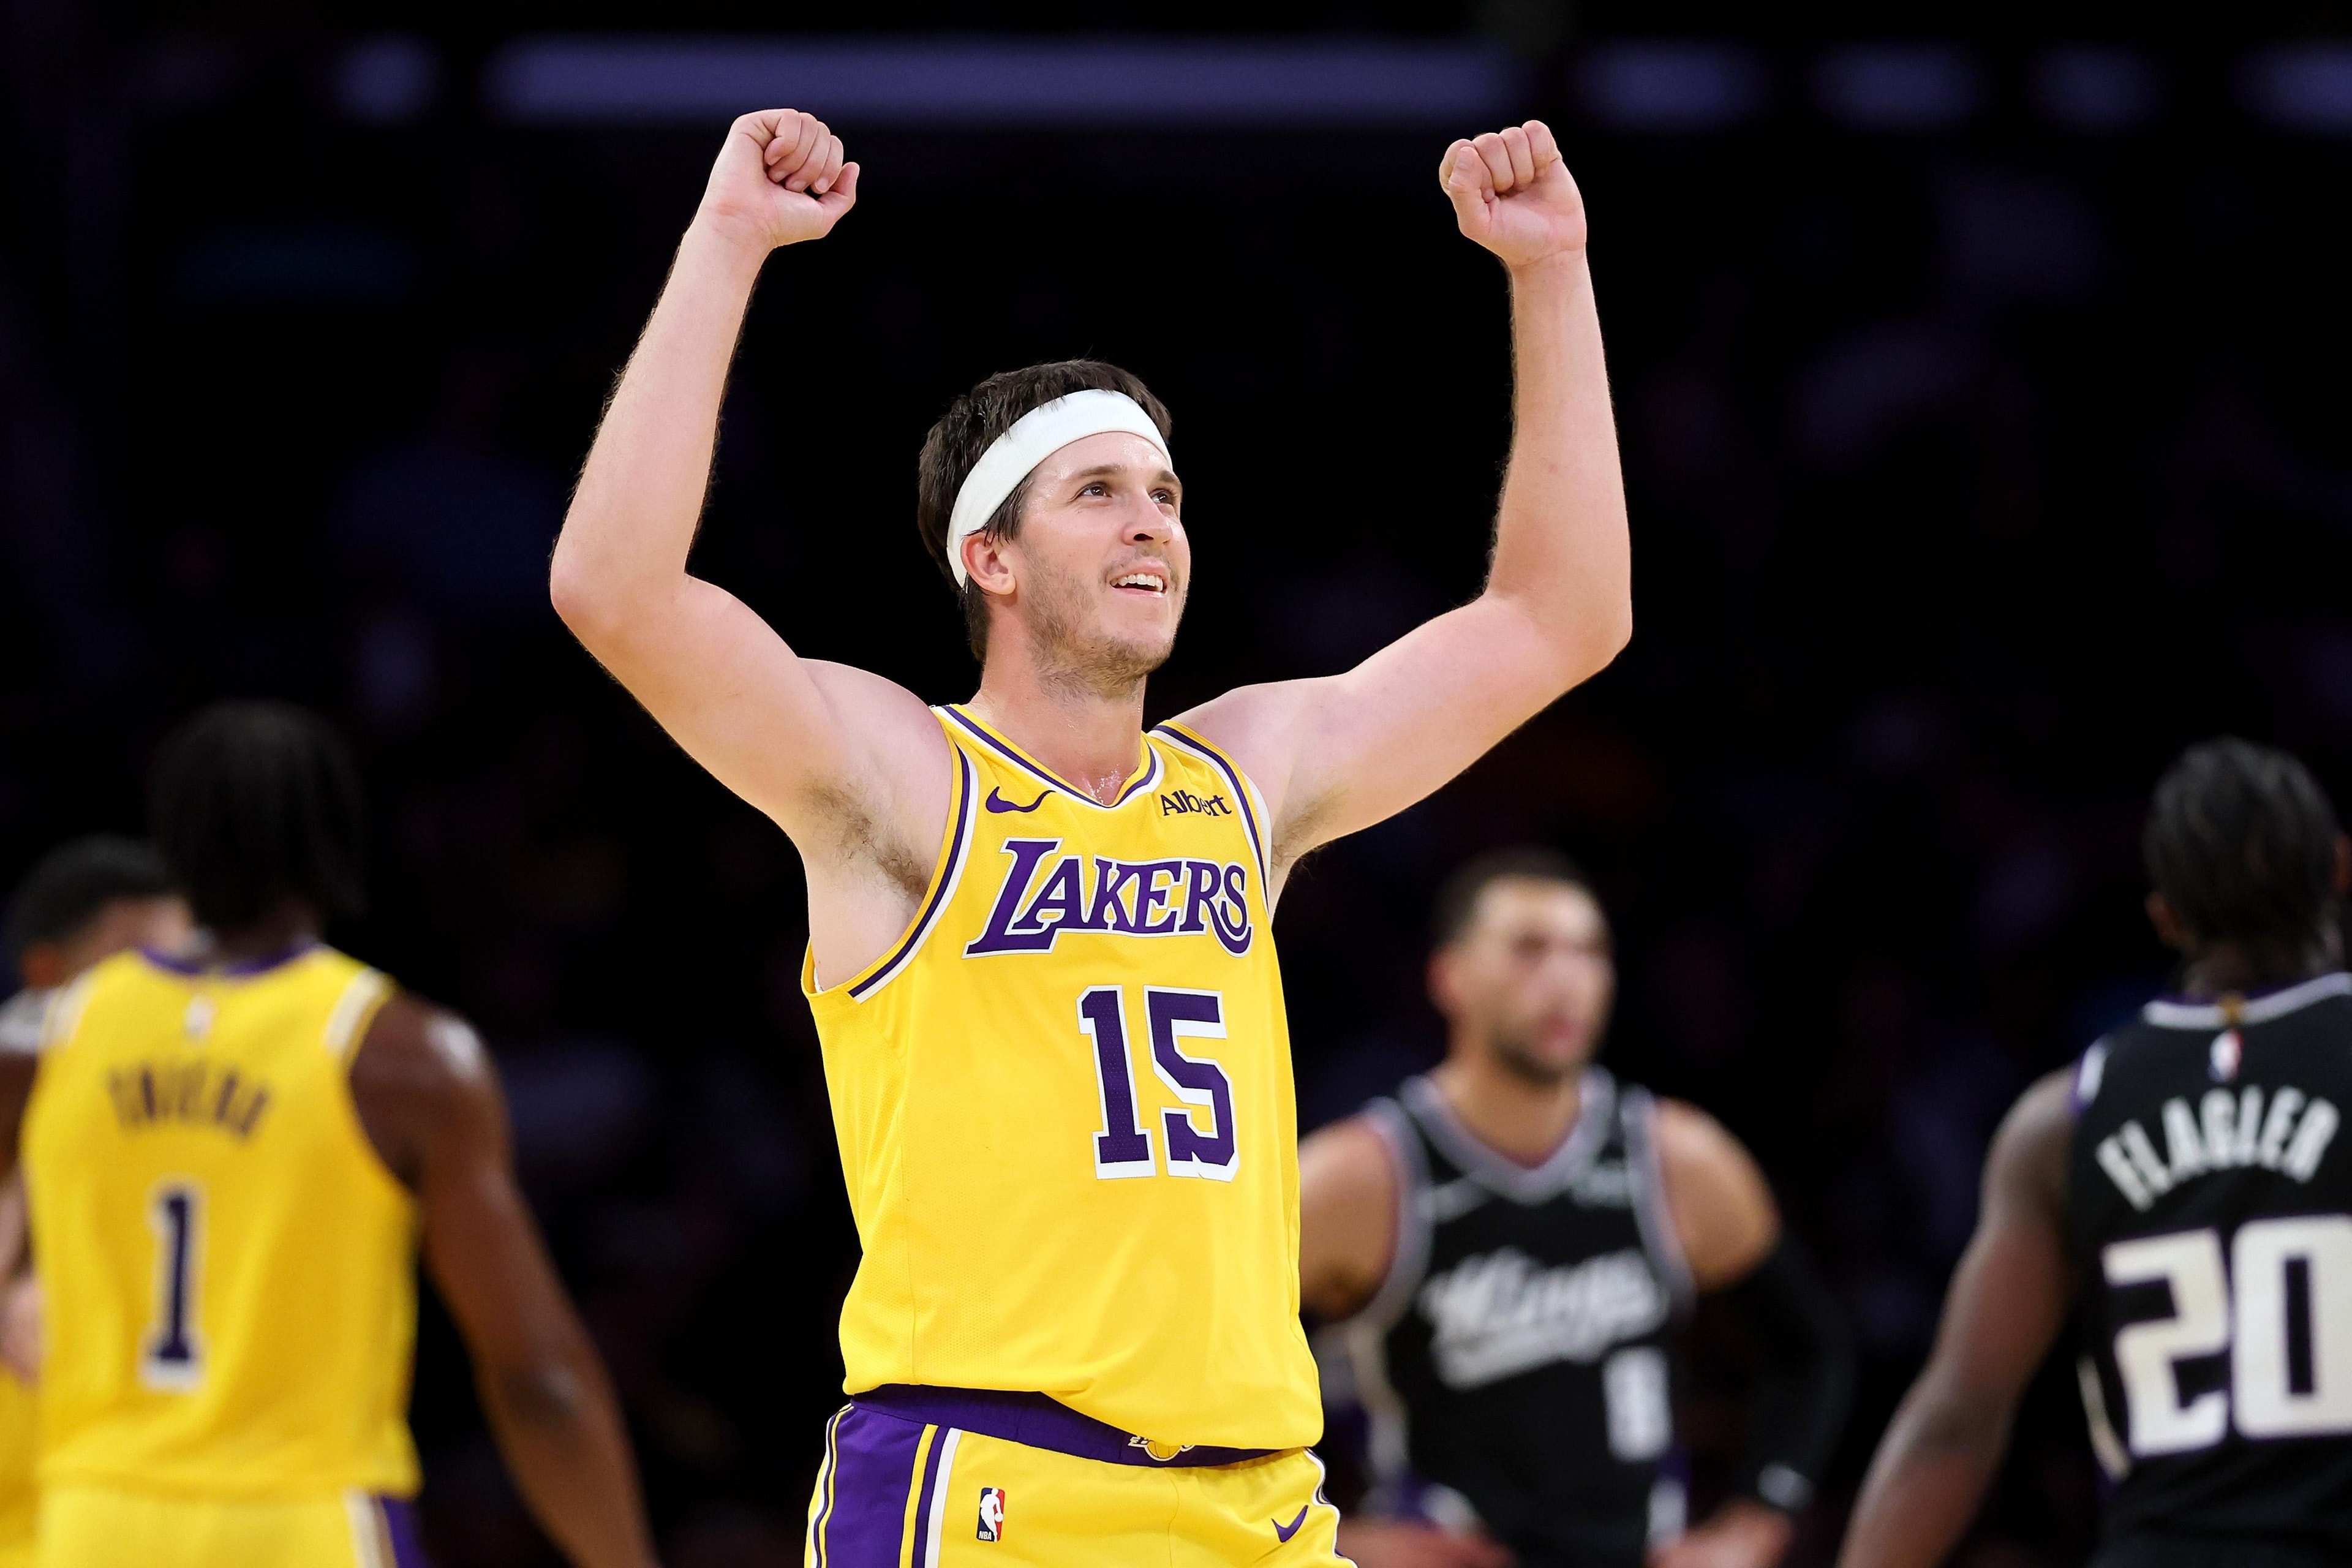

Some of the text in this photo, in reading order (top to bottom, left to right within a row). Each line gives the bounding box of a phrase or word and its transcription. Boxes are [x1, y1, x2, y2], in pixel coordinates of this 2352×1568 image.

[1160, 790, 1232, 816] Albert
[961, 837, 1254, 959] LAKERS
[1076, 984, 1240, 1183] 15
[140, 1182, 206, 1393] 1
[2101, 1215, 2352, 1457] 20
[978, 1531, 992, 1540] NBA
